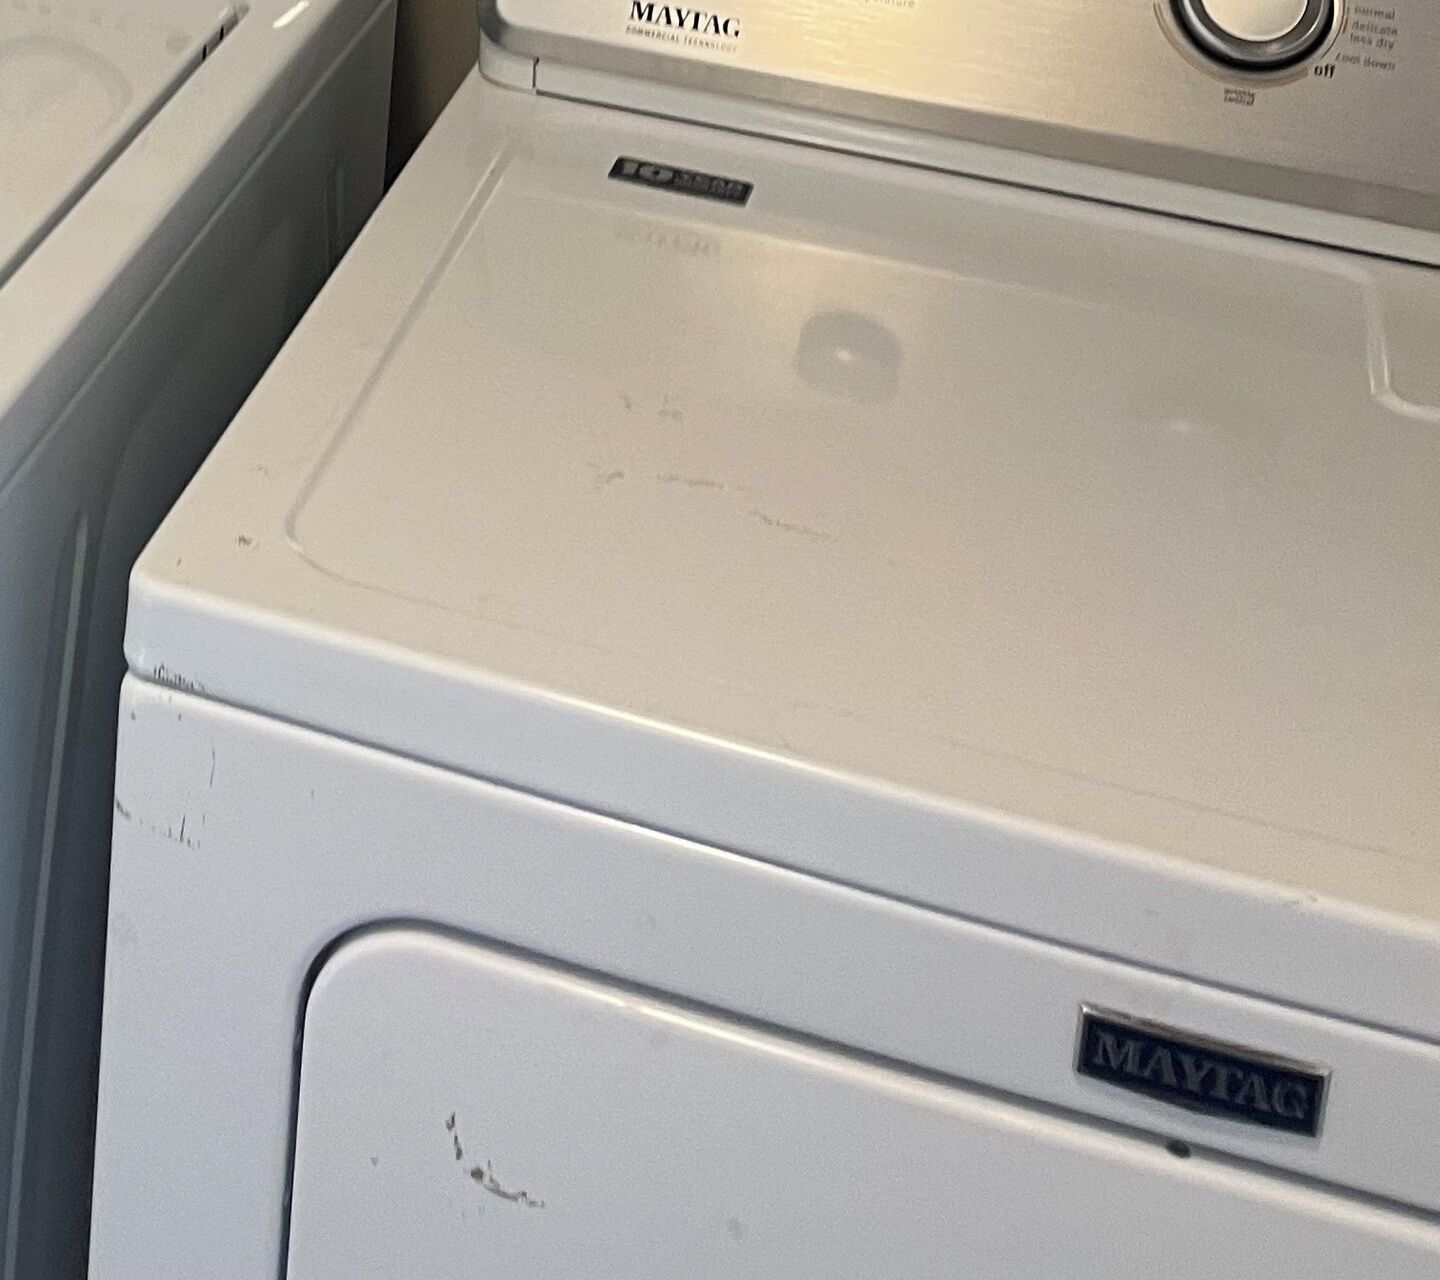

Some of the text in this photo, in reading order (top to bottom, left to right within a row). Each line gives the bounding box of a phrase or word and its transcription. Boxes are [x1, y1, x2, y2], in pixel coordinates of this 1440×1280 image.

[630, 0, 740, 38] MAYTAG
[1314, 64, 1336, 80] off
[1093, 1031, 1306, 1120] MAYTAG
